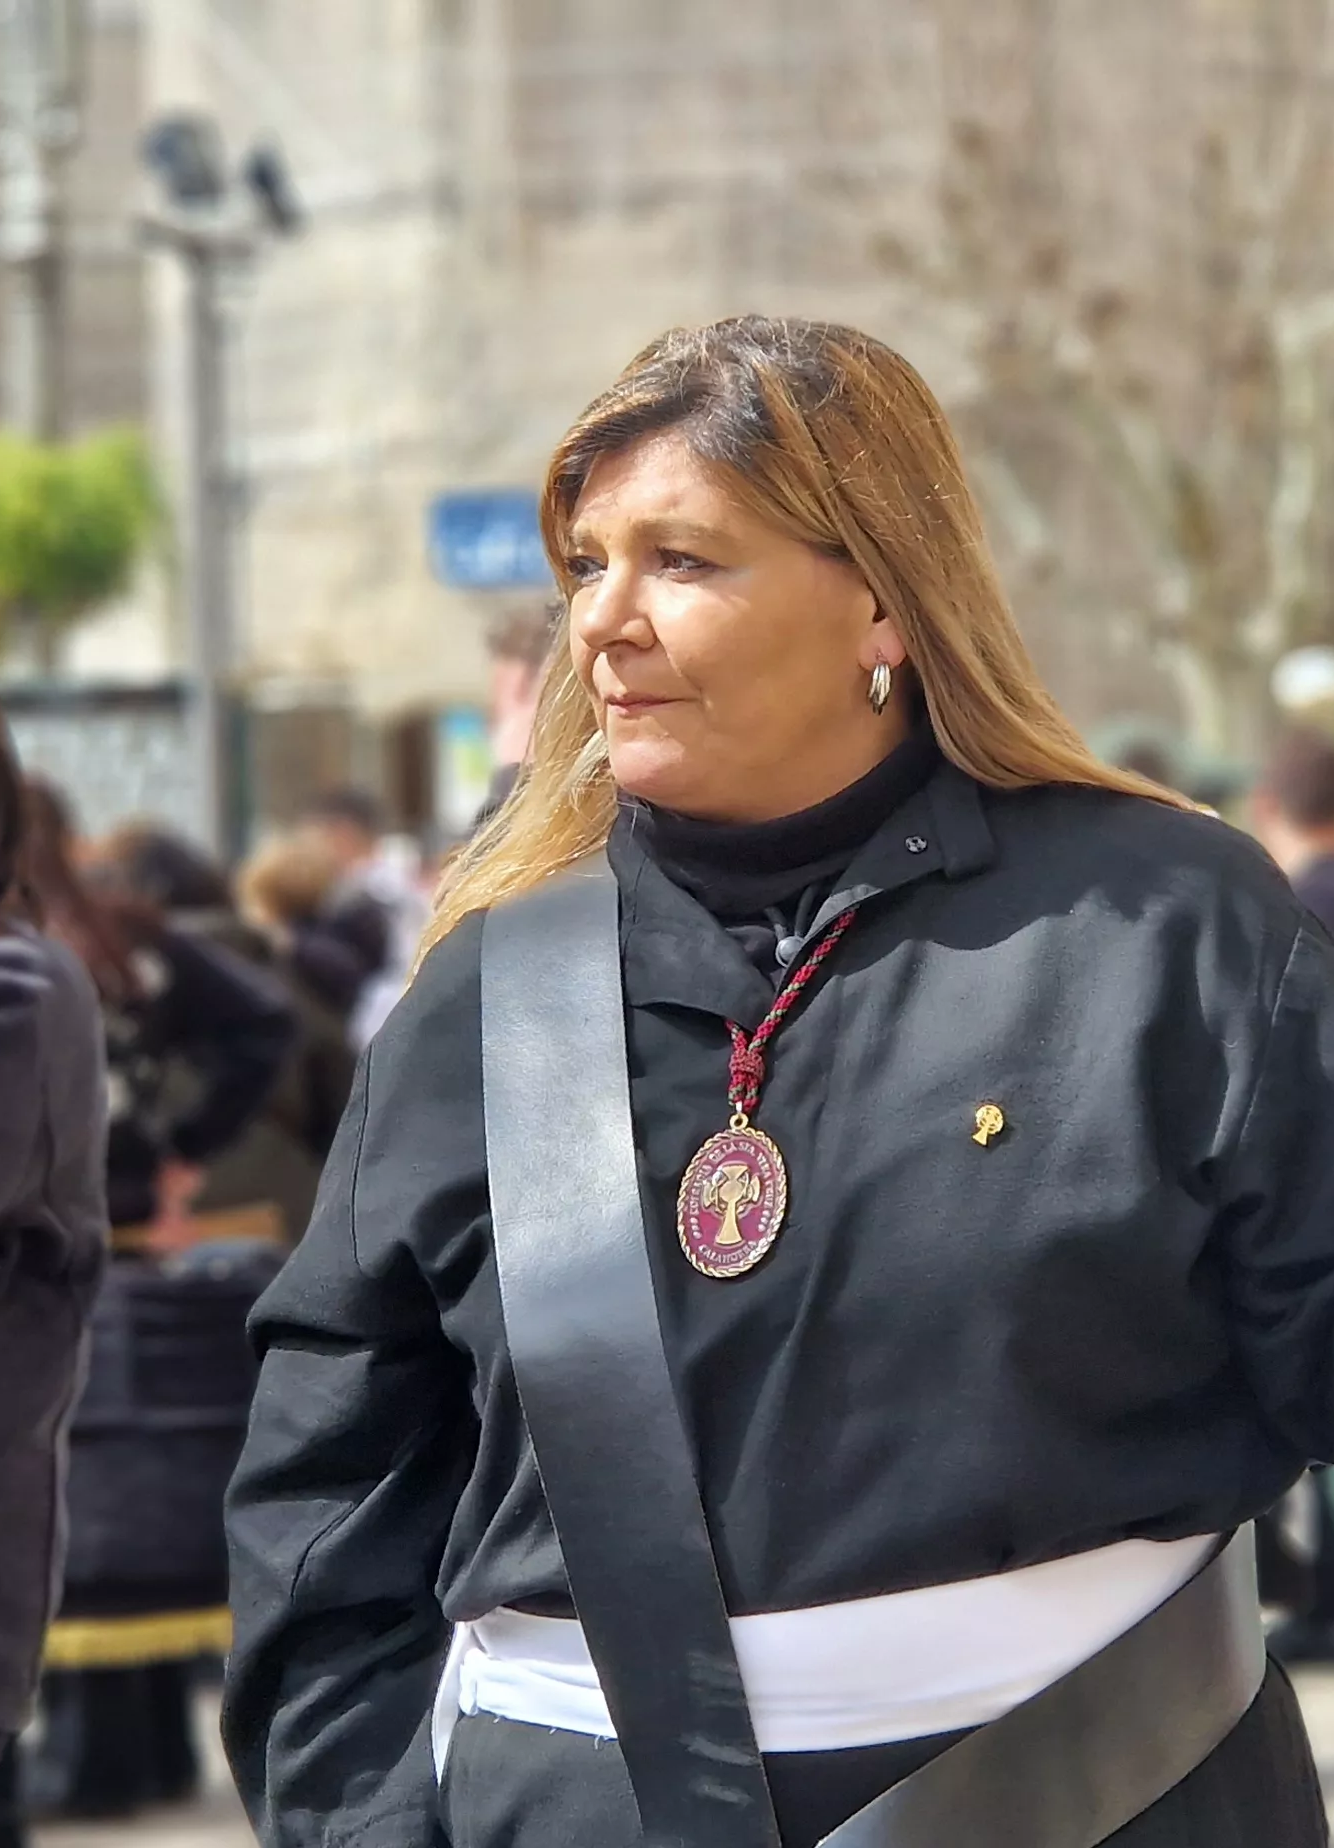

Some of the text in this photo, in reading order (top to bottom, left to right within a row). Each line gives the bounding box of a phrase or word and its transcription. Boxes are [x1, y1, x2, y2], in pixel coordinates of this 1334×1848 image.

[756, 1152, 772, 1179] VERA
[763, 1180, 774, 1207] CRUZ
[698, 1240, 757, 1264] CALAHORRA
